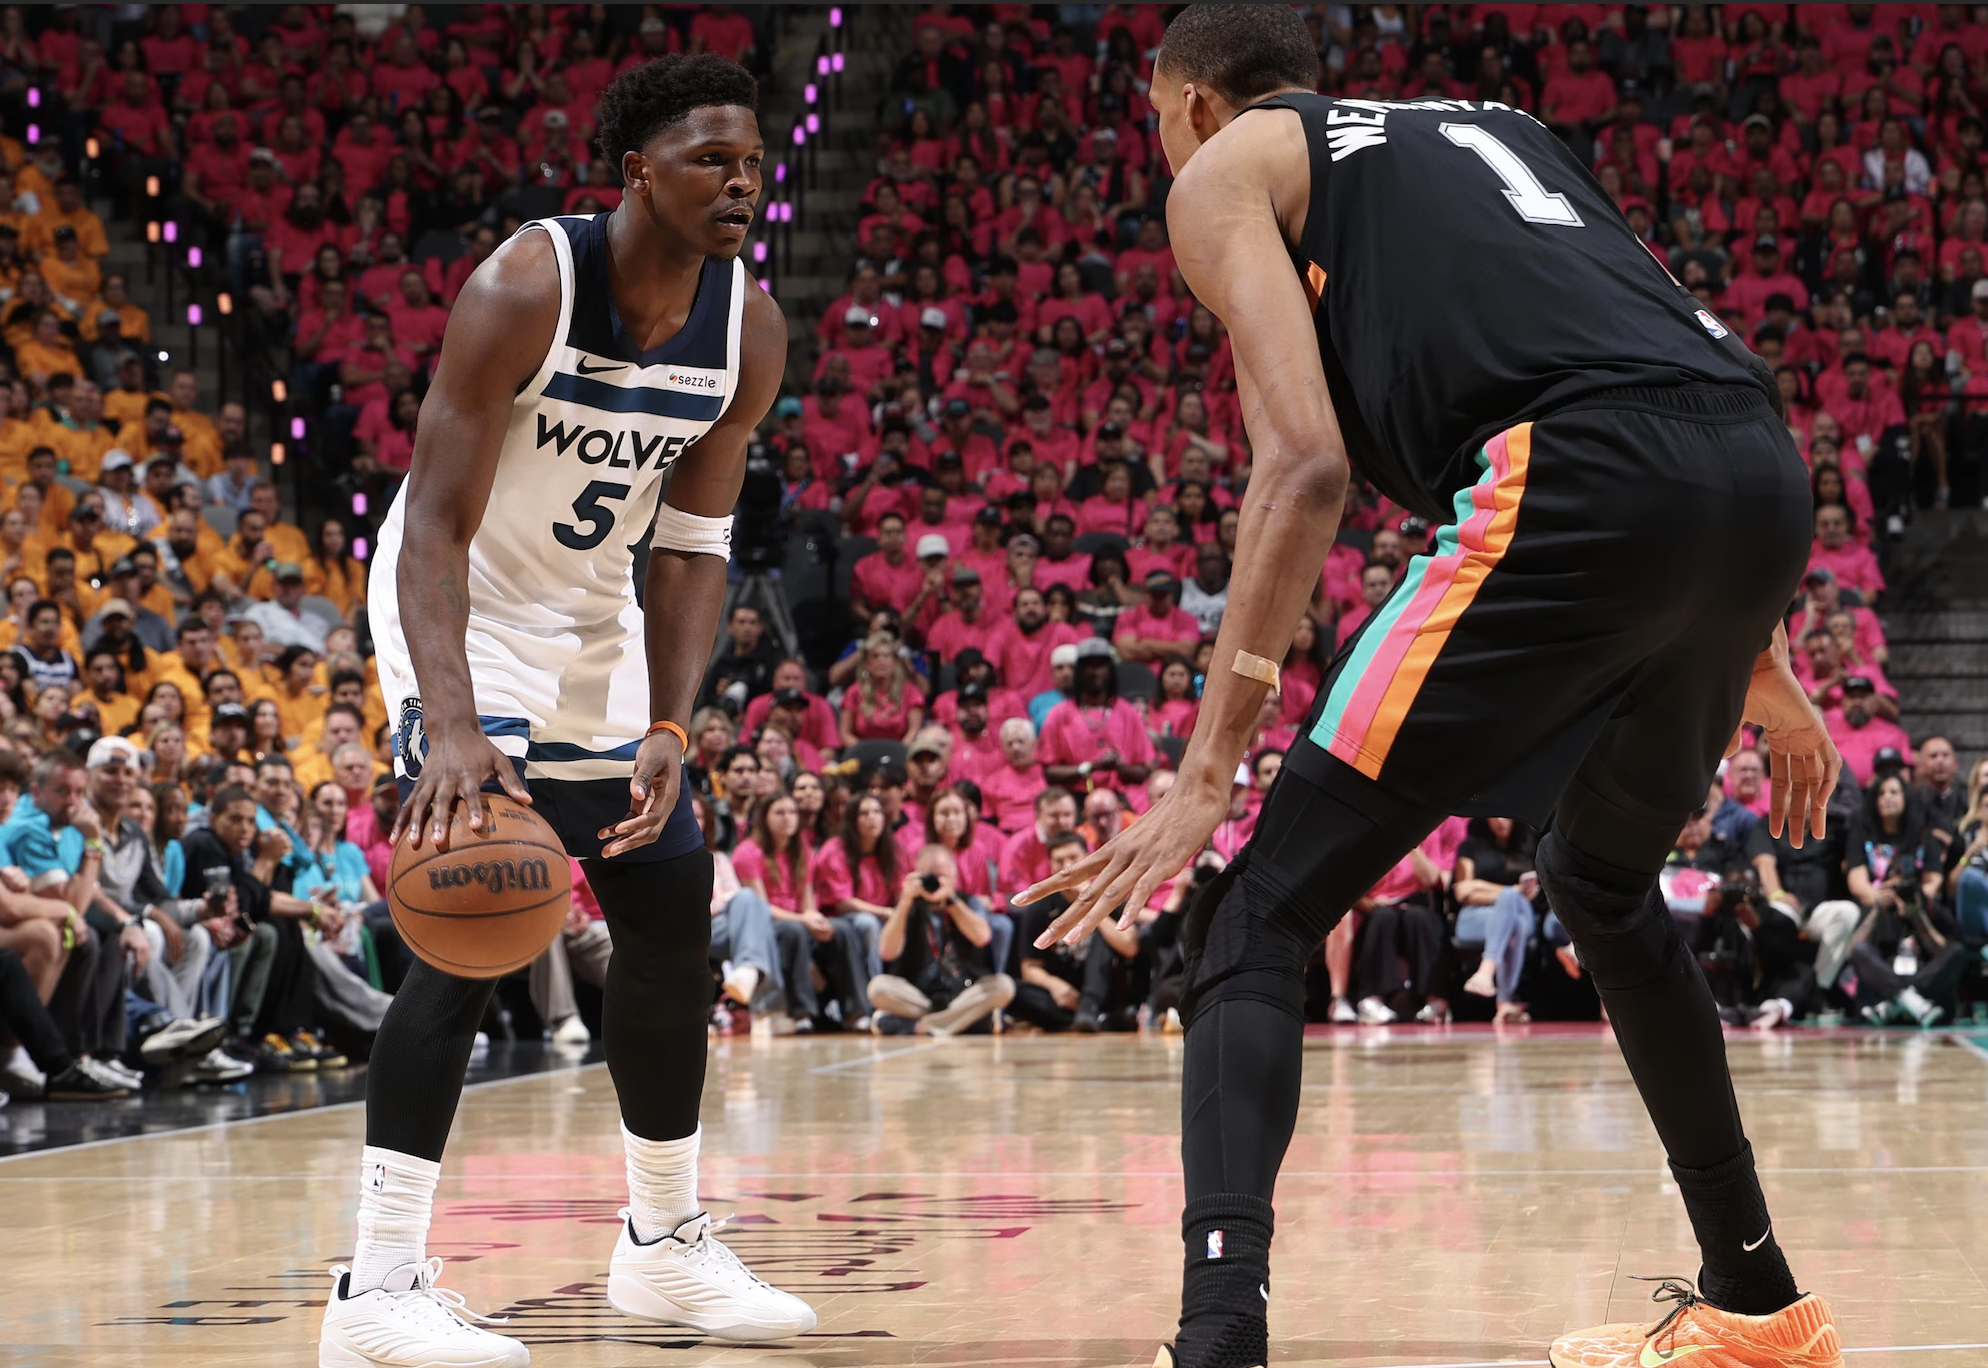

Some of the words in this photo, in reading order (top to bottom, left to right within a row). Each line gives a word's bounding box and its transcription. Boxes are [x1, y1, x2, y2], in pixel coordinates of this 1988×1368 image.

[1437, 121, 1586, 228] 1
[677, 375, 717, 389] sezzle
[552, 480, 631, 551] 5
[426, 856, 552, 895] Wilson
